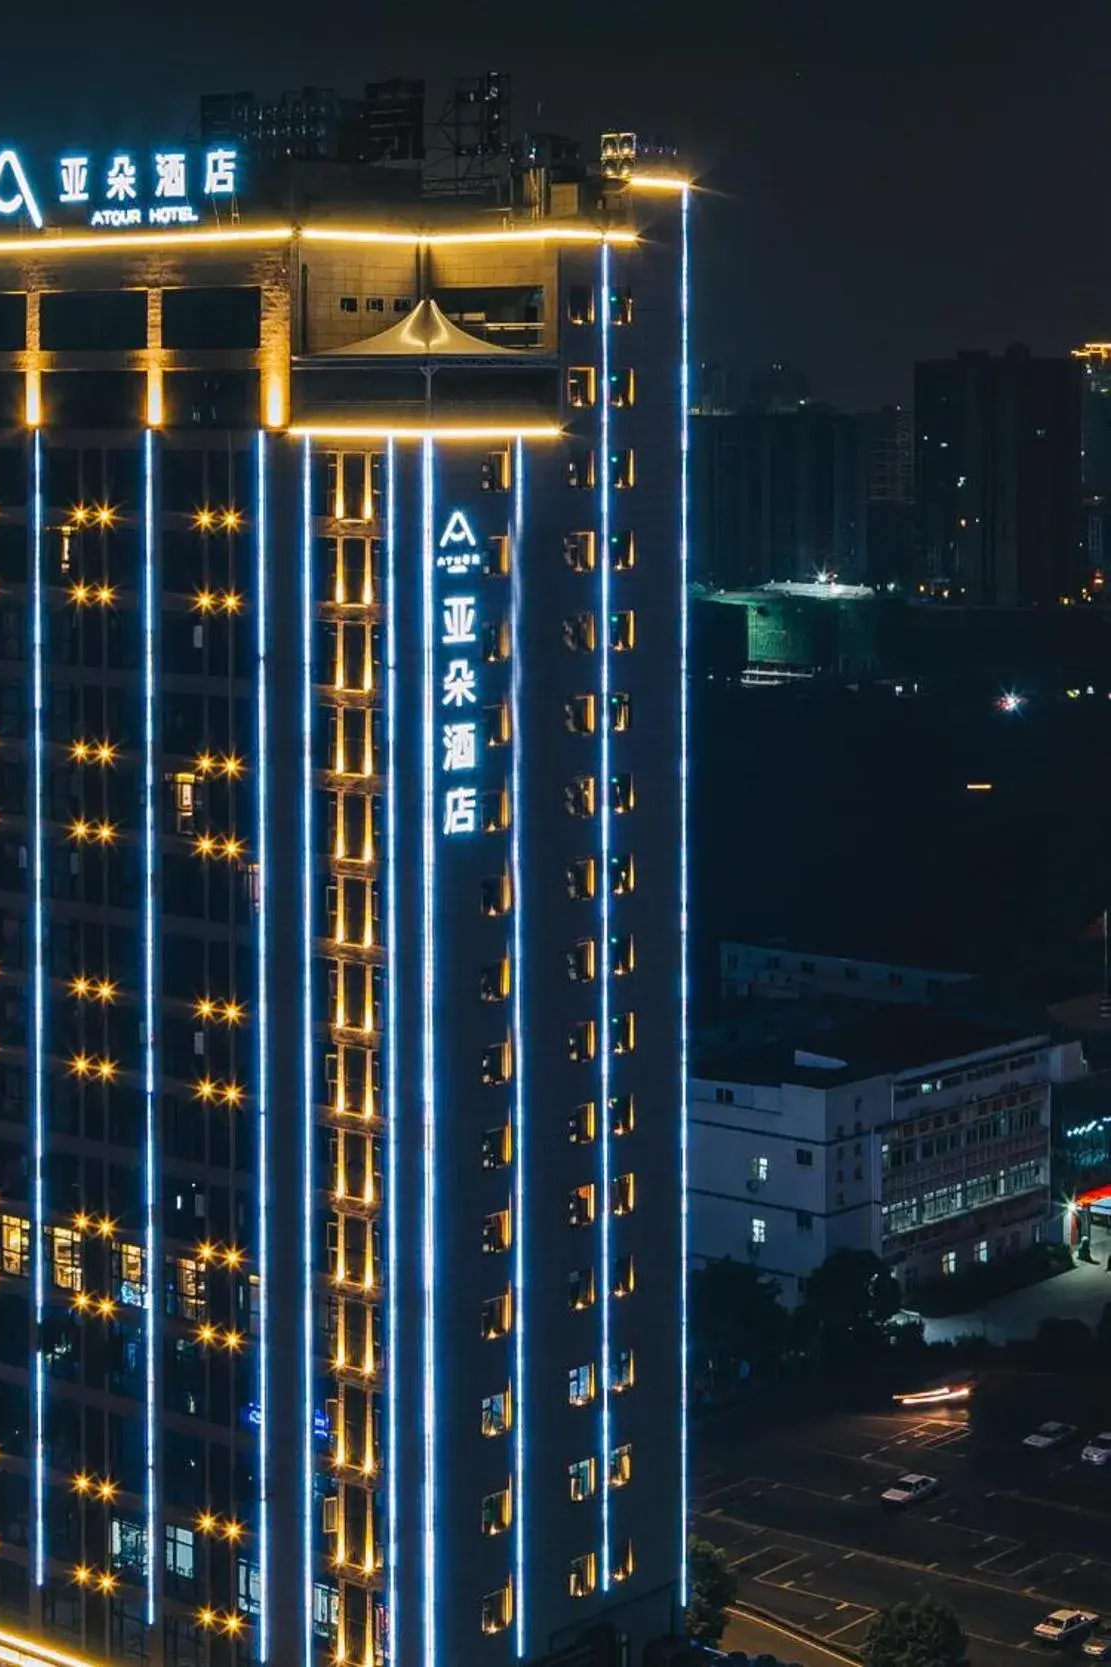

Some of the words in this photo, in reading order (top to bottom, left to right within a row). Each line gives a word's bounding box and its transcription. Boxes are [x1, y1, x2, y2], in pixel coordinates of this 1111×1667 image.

[59, 149, 236, 202] 亚朵酒店
[91, 208, 141, 226] ATOUR
[149, 206, 198, 224] HOTEL
[442, 597, 476, 834] 亚朵酒店
